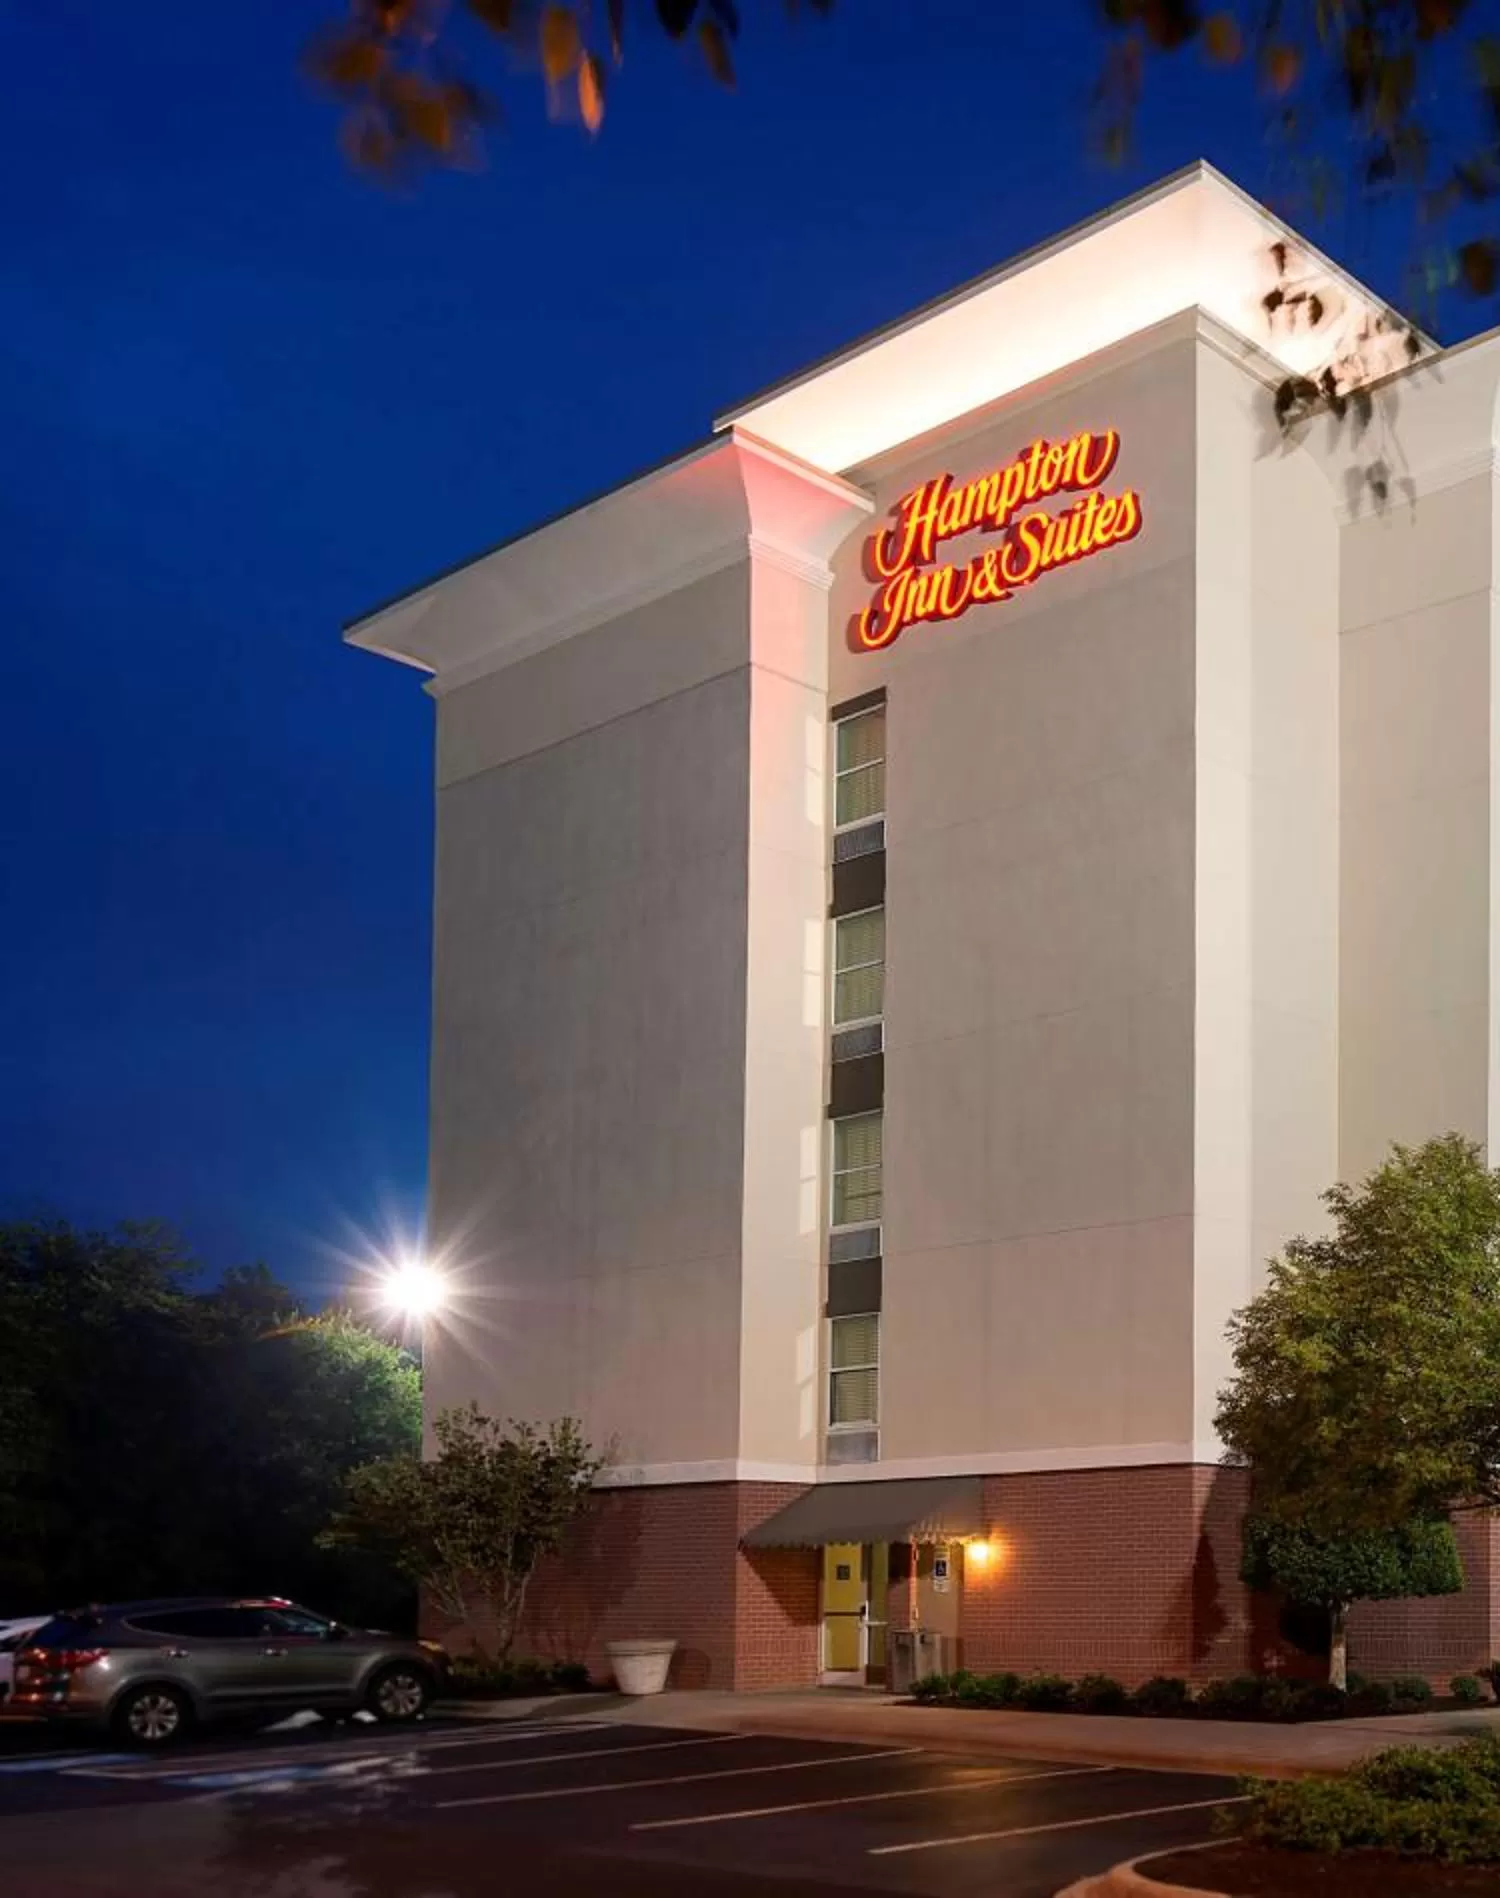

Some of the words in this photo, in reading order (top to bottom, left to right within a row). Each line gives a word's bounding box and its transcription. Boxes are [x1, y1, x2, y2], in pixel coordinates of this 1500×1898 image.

[850, 563, 974, 651] Inn
[971, 548, 1009, 602] &
[1001, 488, 1142, 583] Suites
[866, 431, 1120, 580] Hampton
